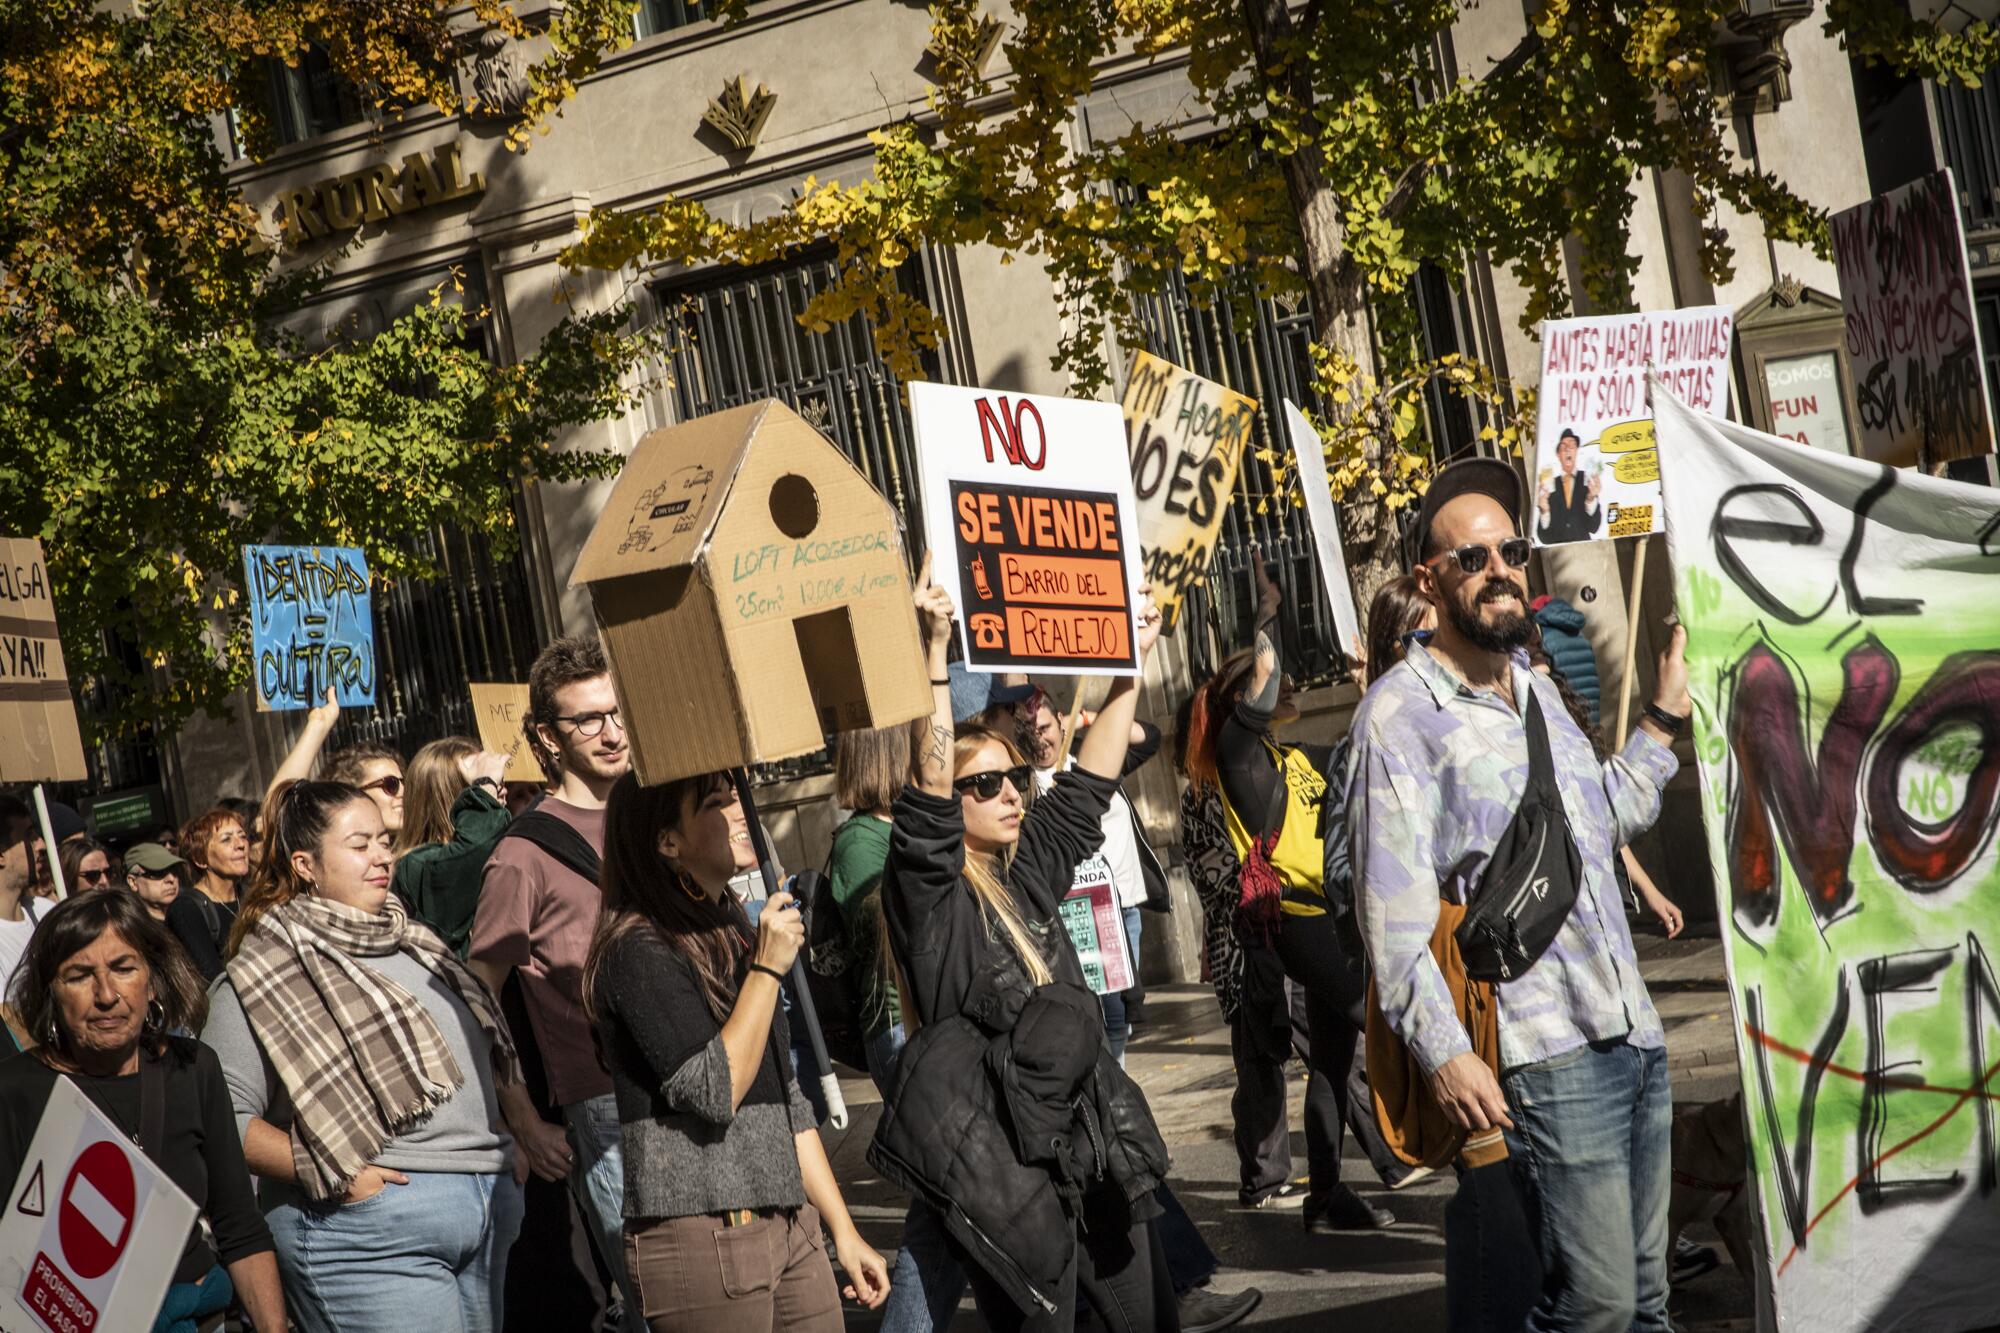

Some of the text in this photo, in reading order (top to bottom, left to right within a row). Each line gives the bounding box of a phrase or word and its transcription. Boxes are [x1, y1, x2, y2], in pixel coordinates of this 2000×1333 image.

[275, 140, 486, 248] RURAL
[1547, 315, 1730, 376] ANTES HABÍA FAMILIAS
[1558, 365, 1714, 424] HOY SÓLO TRISTAS
[1766, 363, 1833, 388] SOMOS
[974, 396, 1047, 471] NO
[1771, 394, 1819, 420] FUN
[1163, 450, 1225, 528] ES
[957, 490, 1120, 552] SE VENDE
[733, 530, 890, 582] LOFT ACOGEDOR
[1006, 557, 1107, 597] BARRIO DEL
[1021, 609, 1118, 656] REALEJO
[1717, 630, 2000, 928] NO
[1906, 771, 1953, 821] NO
[33, 1287, 79, 1333] EL PASO
[35, 1259, 94, 1327] PROHIBIDO
